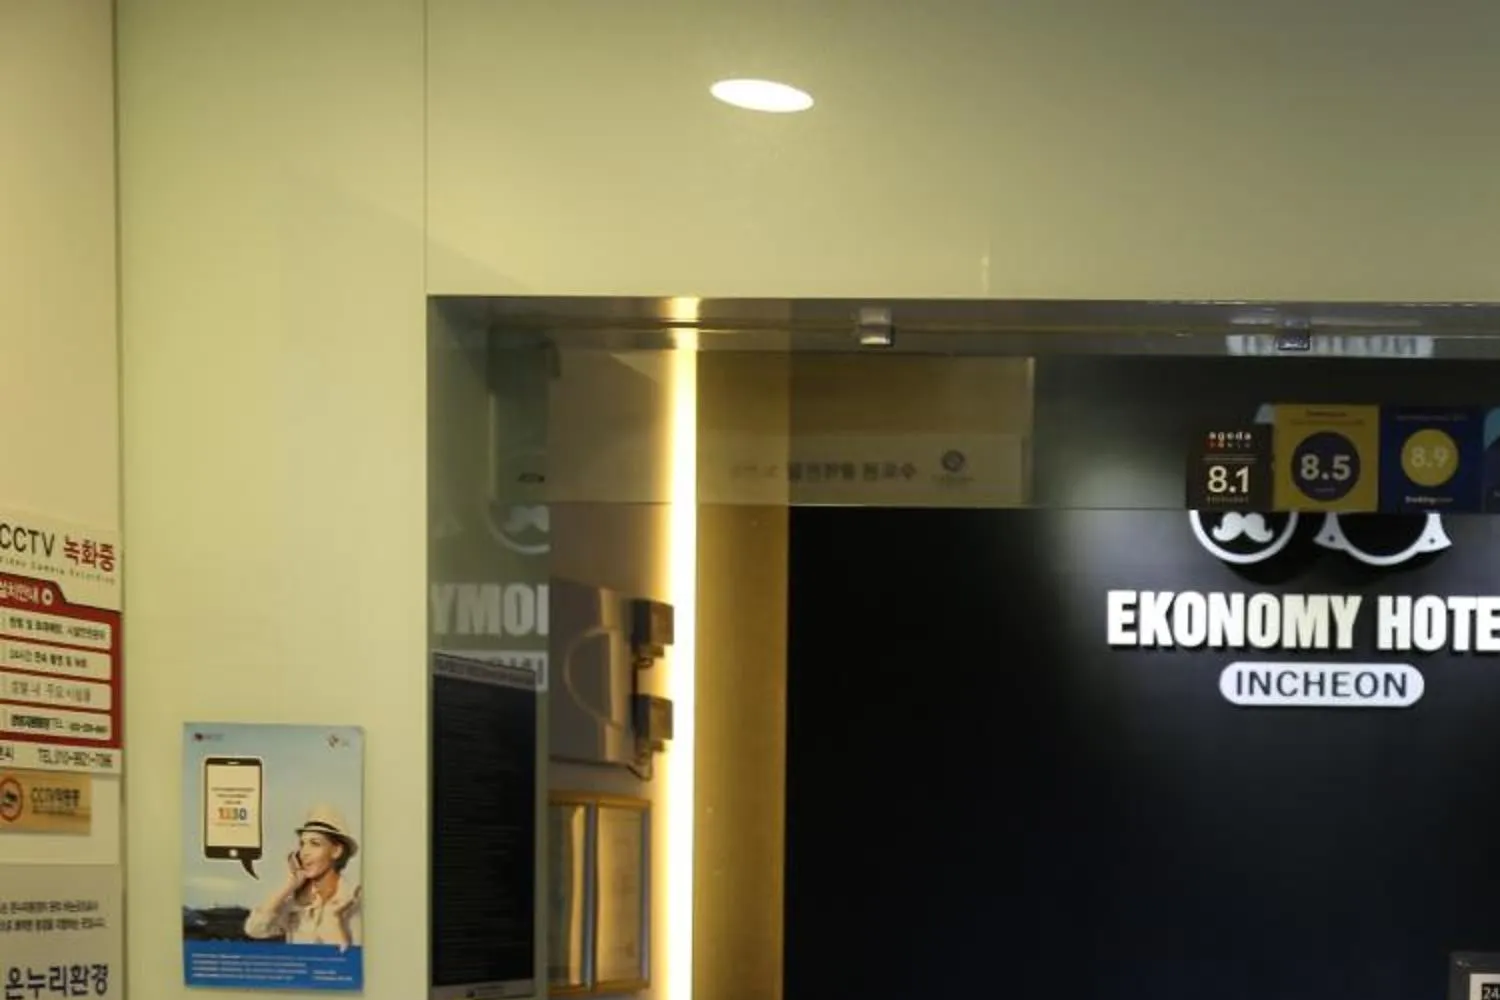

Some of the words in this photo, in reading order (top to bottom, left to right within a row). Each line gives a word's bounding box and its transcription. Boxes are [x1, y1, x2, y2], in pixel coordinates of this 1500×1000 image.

[1208, 431, 1252, 442] agoda
[1300, 453, 1352, 481] 8.5
[1410, 446, 1448, 469] 8.9
[1207, 465, 1250, 494] 8.1
[0, 524, 55, 557] CCTV
[64, 535, 116, 572] 녹화중
[1107, 589, 1361, 650] EKONOMY
[1235, 670, 1408, 698] INCHEON
[5, 963, 109, 1000] 온누리환경
